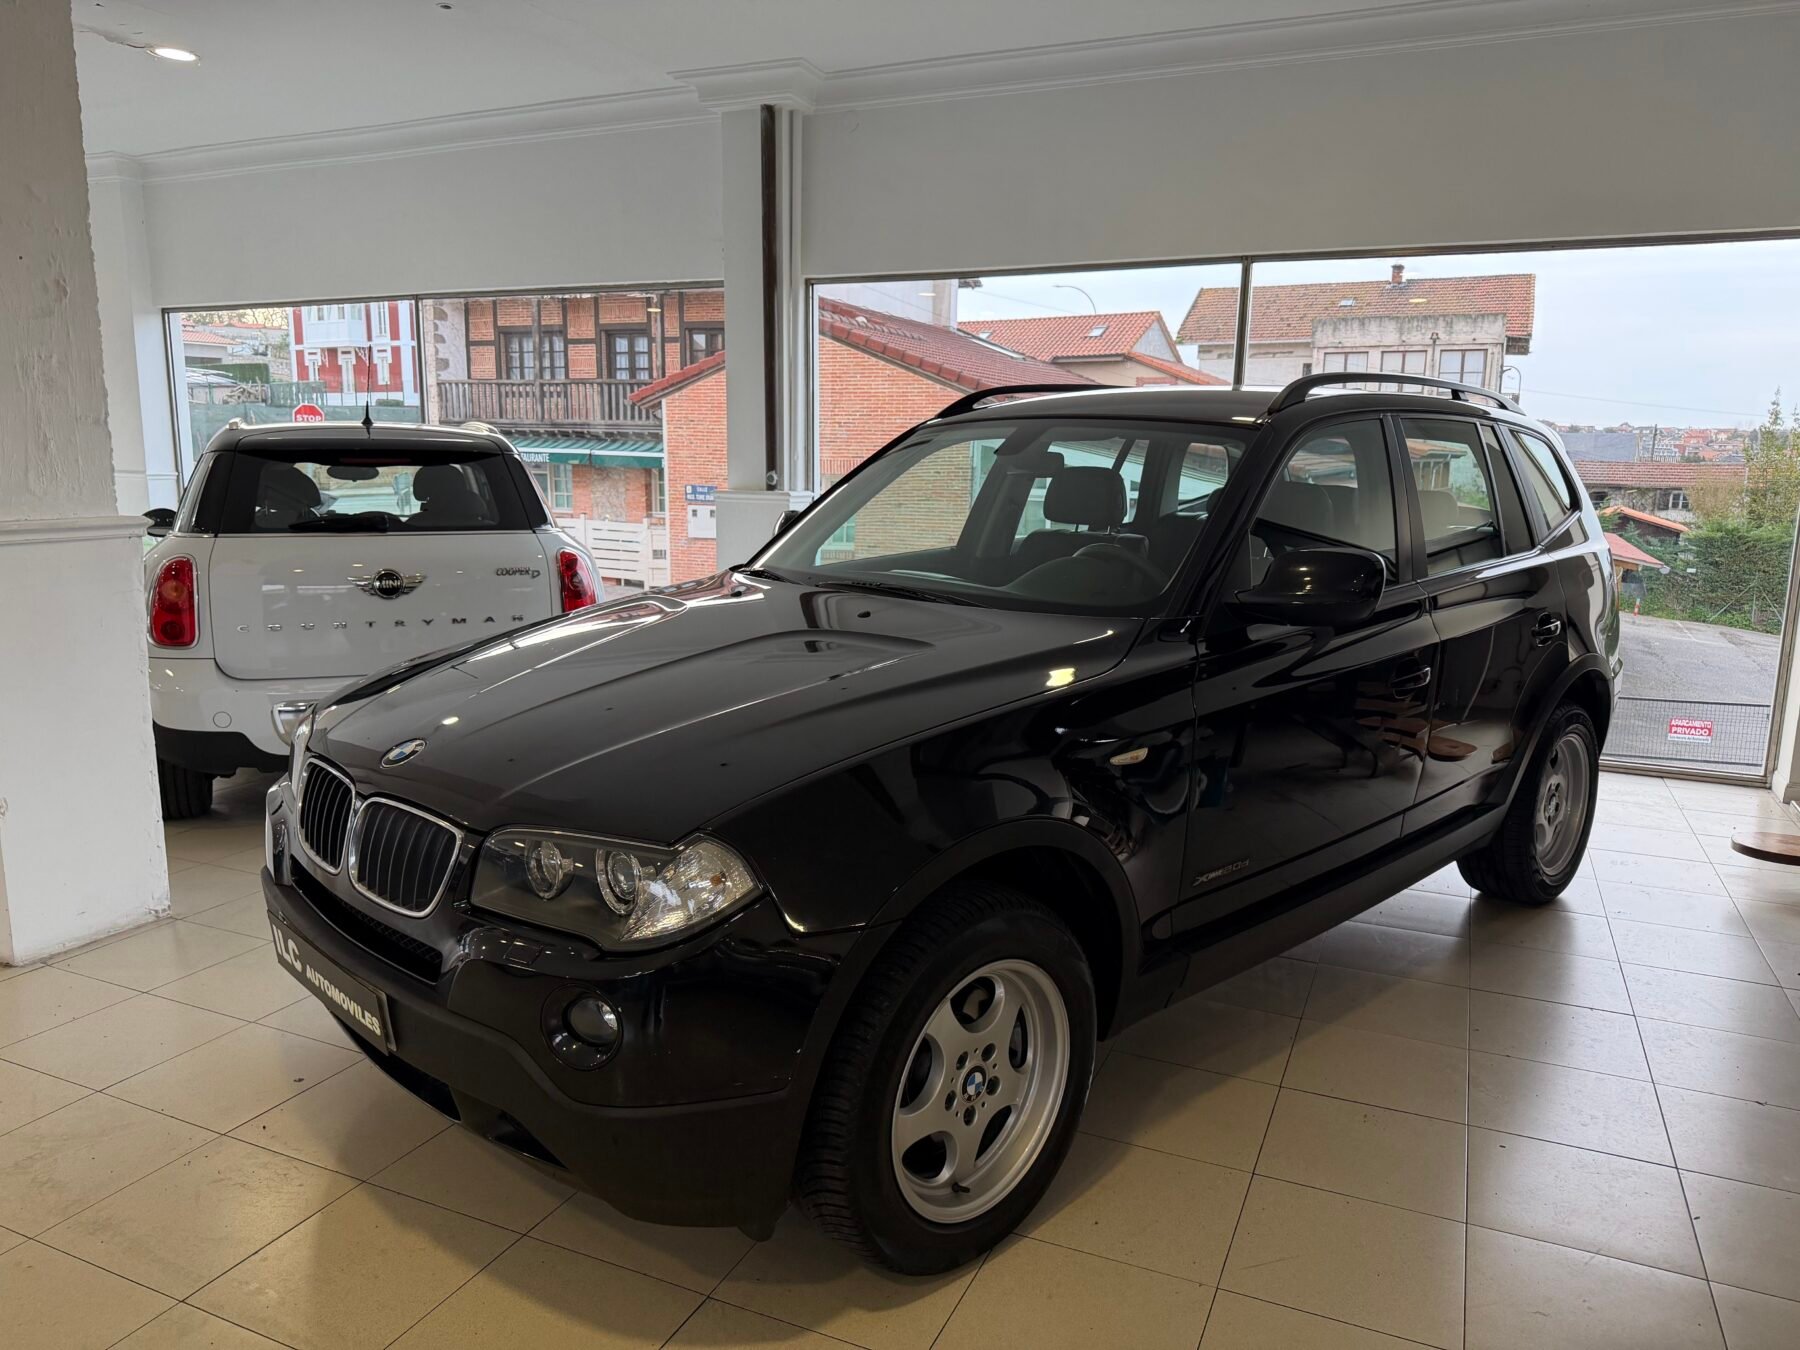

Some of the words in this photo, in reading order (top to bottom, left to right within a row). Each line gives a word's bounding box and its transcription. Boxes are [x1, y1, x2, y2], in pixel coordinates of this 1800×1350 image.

[296, 414, 321, 422] STOP
[496, 566, 530, 576] COOPER
[531, 569, 541, 579] D
[375, 579, 400, 589] MINI
[235, 614, 526, 633] COUNTRYMAN
[1671, 718, 1712, 729] APARCAMIENTO
[1671, 726, 1709, 736] PRIVADO
[306, 964, 381, 1036] AUTOMOVILES
